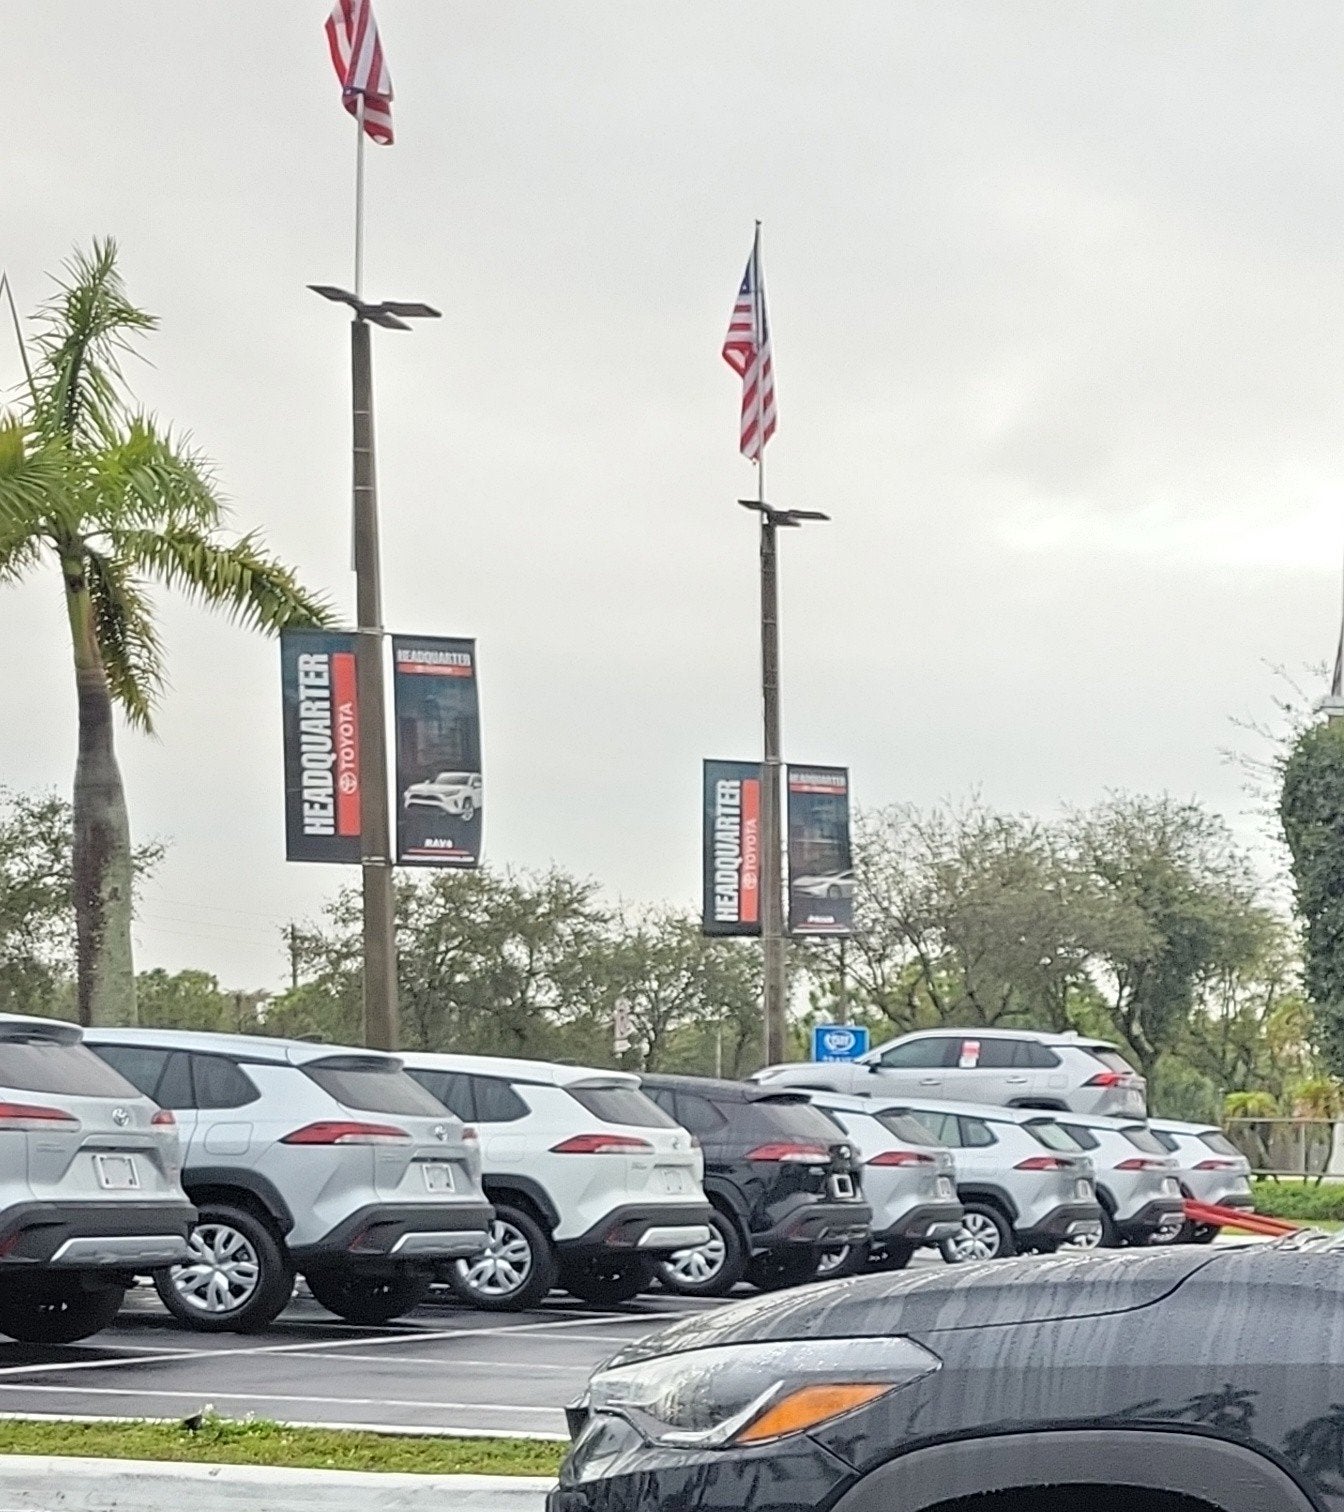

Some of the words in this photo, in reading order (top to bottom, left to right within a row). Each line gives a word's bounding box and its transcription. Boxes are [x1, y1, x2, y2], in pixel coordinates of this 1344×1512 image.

[397, 649, 471, 666] HEADQUARTER
[298, 653, 337, 836] HEADQUARTER
[340, 702, 358, 769] TOYOTA
[714, 779, 743, 922] HEADQUARTER
[744, 819, 757, 871] TOYOTA
